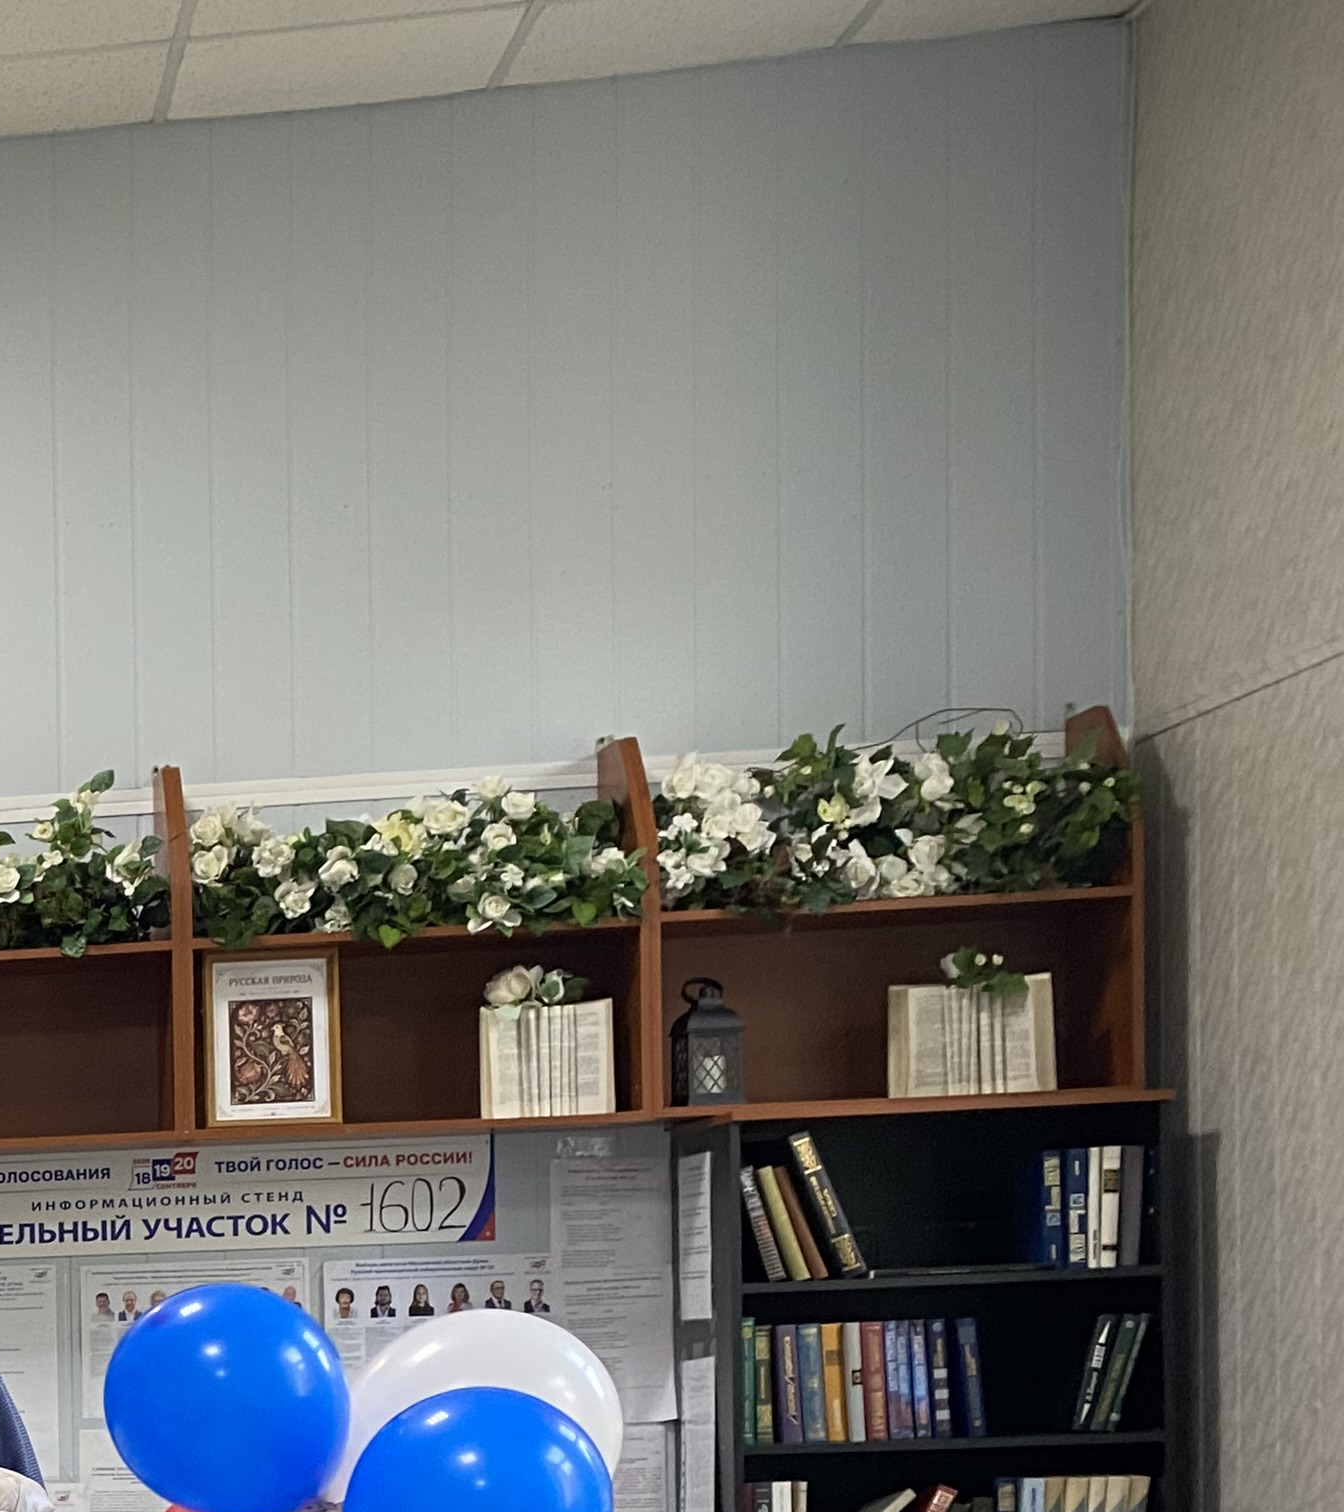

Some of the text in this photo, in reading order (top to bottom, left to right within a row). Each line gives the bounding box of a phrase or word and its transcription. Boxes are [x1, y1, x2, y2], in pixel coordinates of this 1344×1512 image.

[228, 974, 312, 987] РУССКАЯ ПРИРОДА
[135, 1157, 194, 1185] 18 19 20
[215, 1151, 473, 1173] ТВОЙ ГОЛОС СИЛА РОССИИ!
[31, 1191, 304, 1212] ИНФОРМАЦИОННЫЙ СТЕНД
[142, 1213, 291, 1240] УЧАСТОК
[306, 1203, 347, 1235] №
[360, 1177, 467, 1233] 1602
